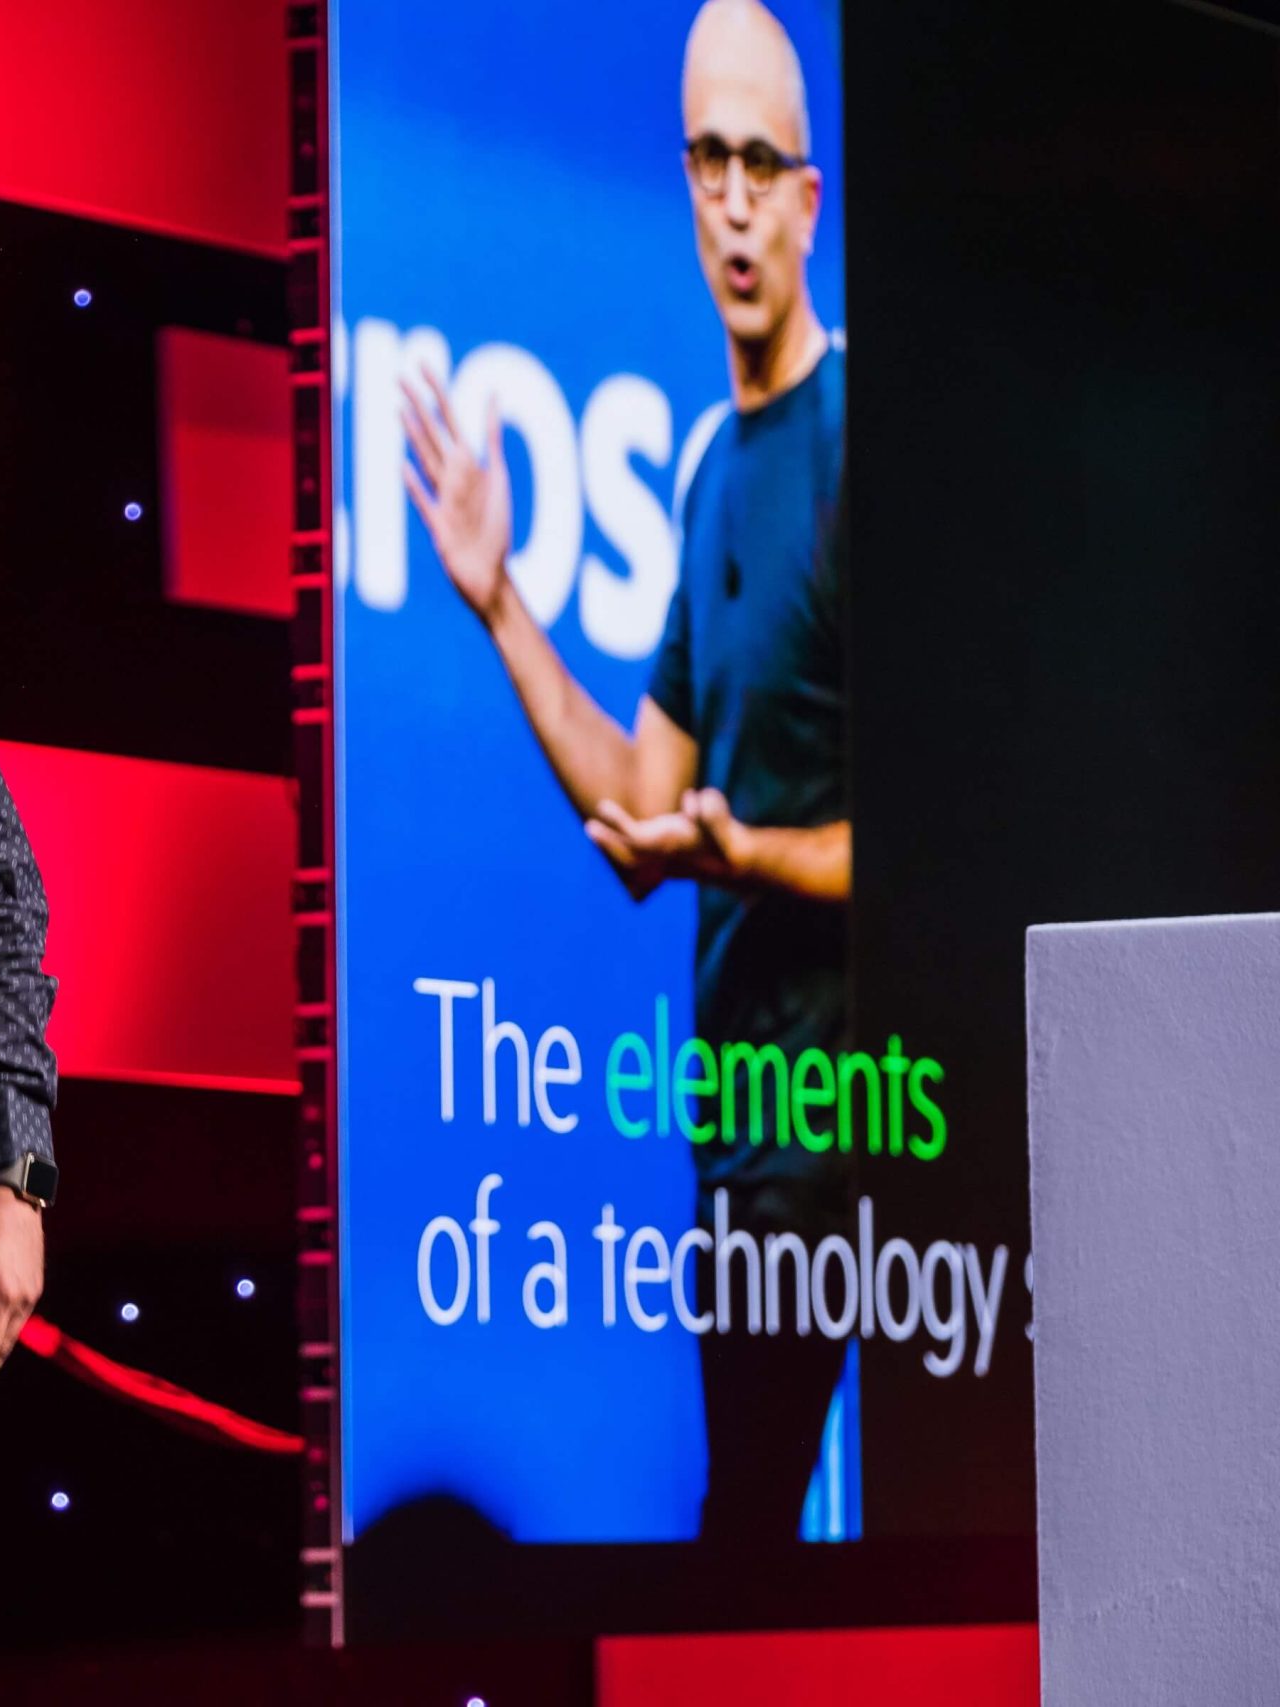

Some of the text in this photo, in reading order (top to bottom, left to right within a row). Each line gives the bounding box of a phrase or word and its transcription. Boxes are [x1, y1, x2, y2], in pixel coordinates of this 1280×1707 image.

[333, 314, 732, 661] ros
[413, 977, 948, 1160] The elements
[417, 1173, 503, 1326] of
[522, 1221, 568, 1330] a
[593, 1187, 1010, 1378] technology
